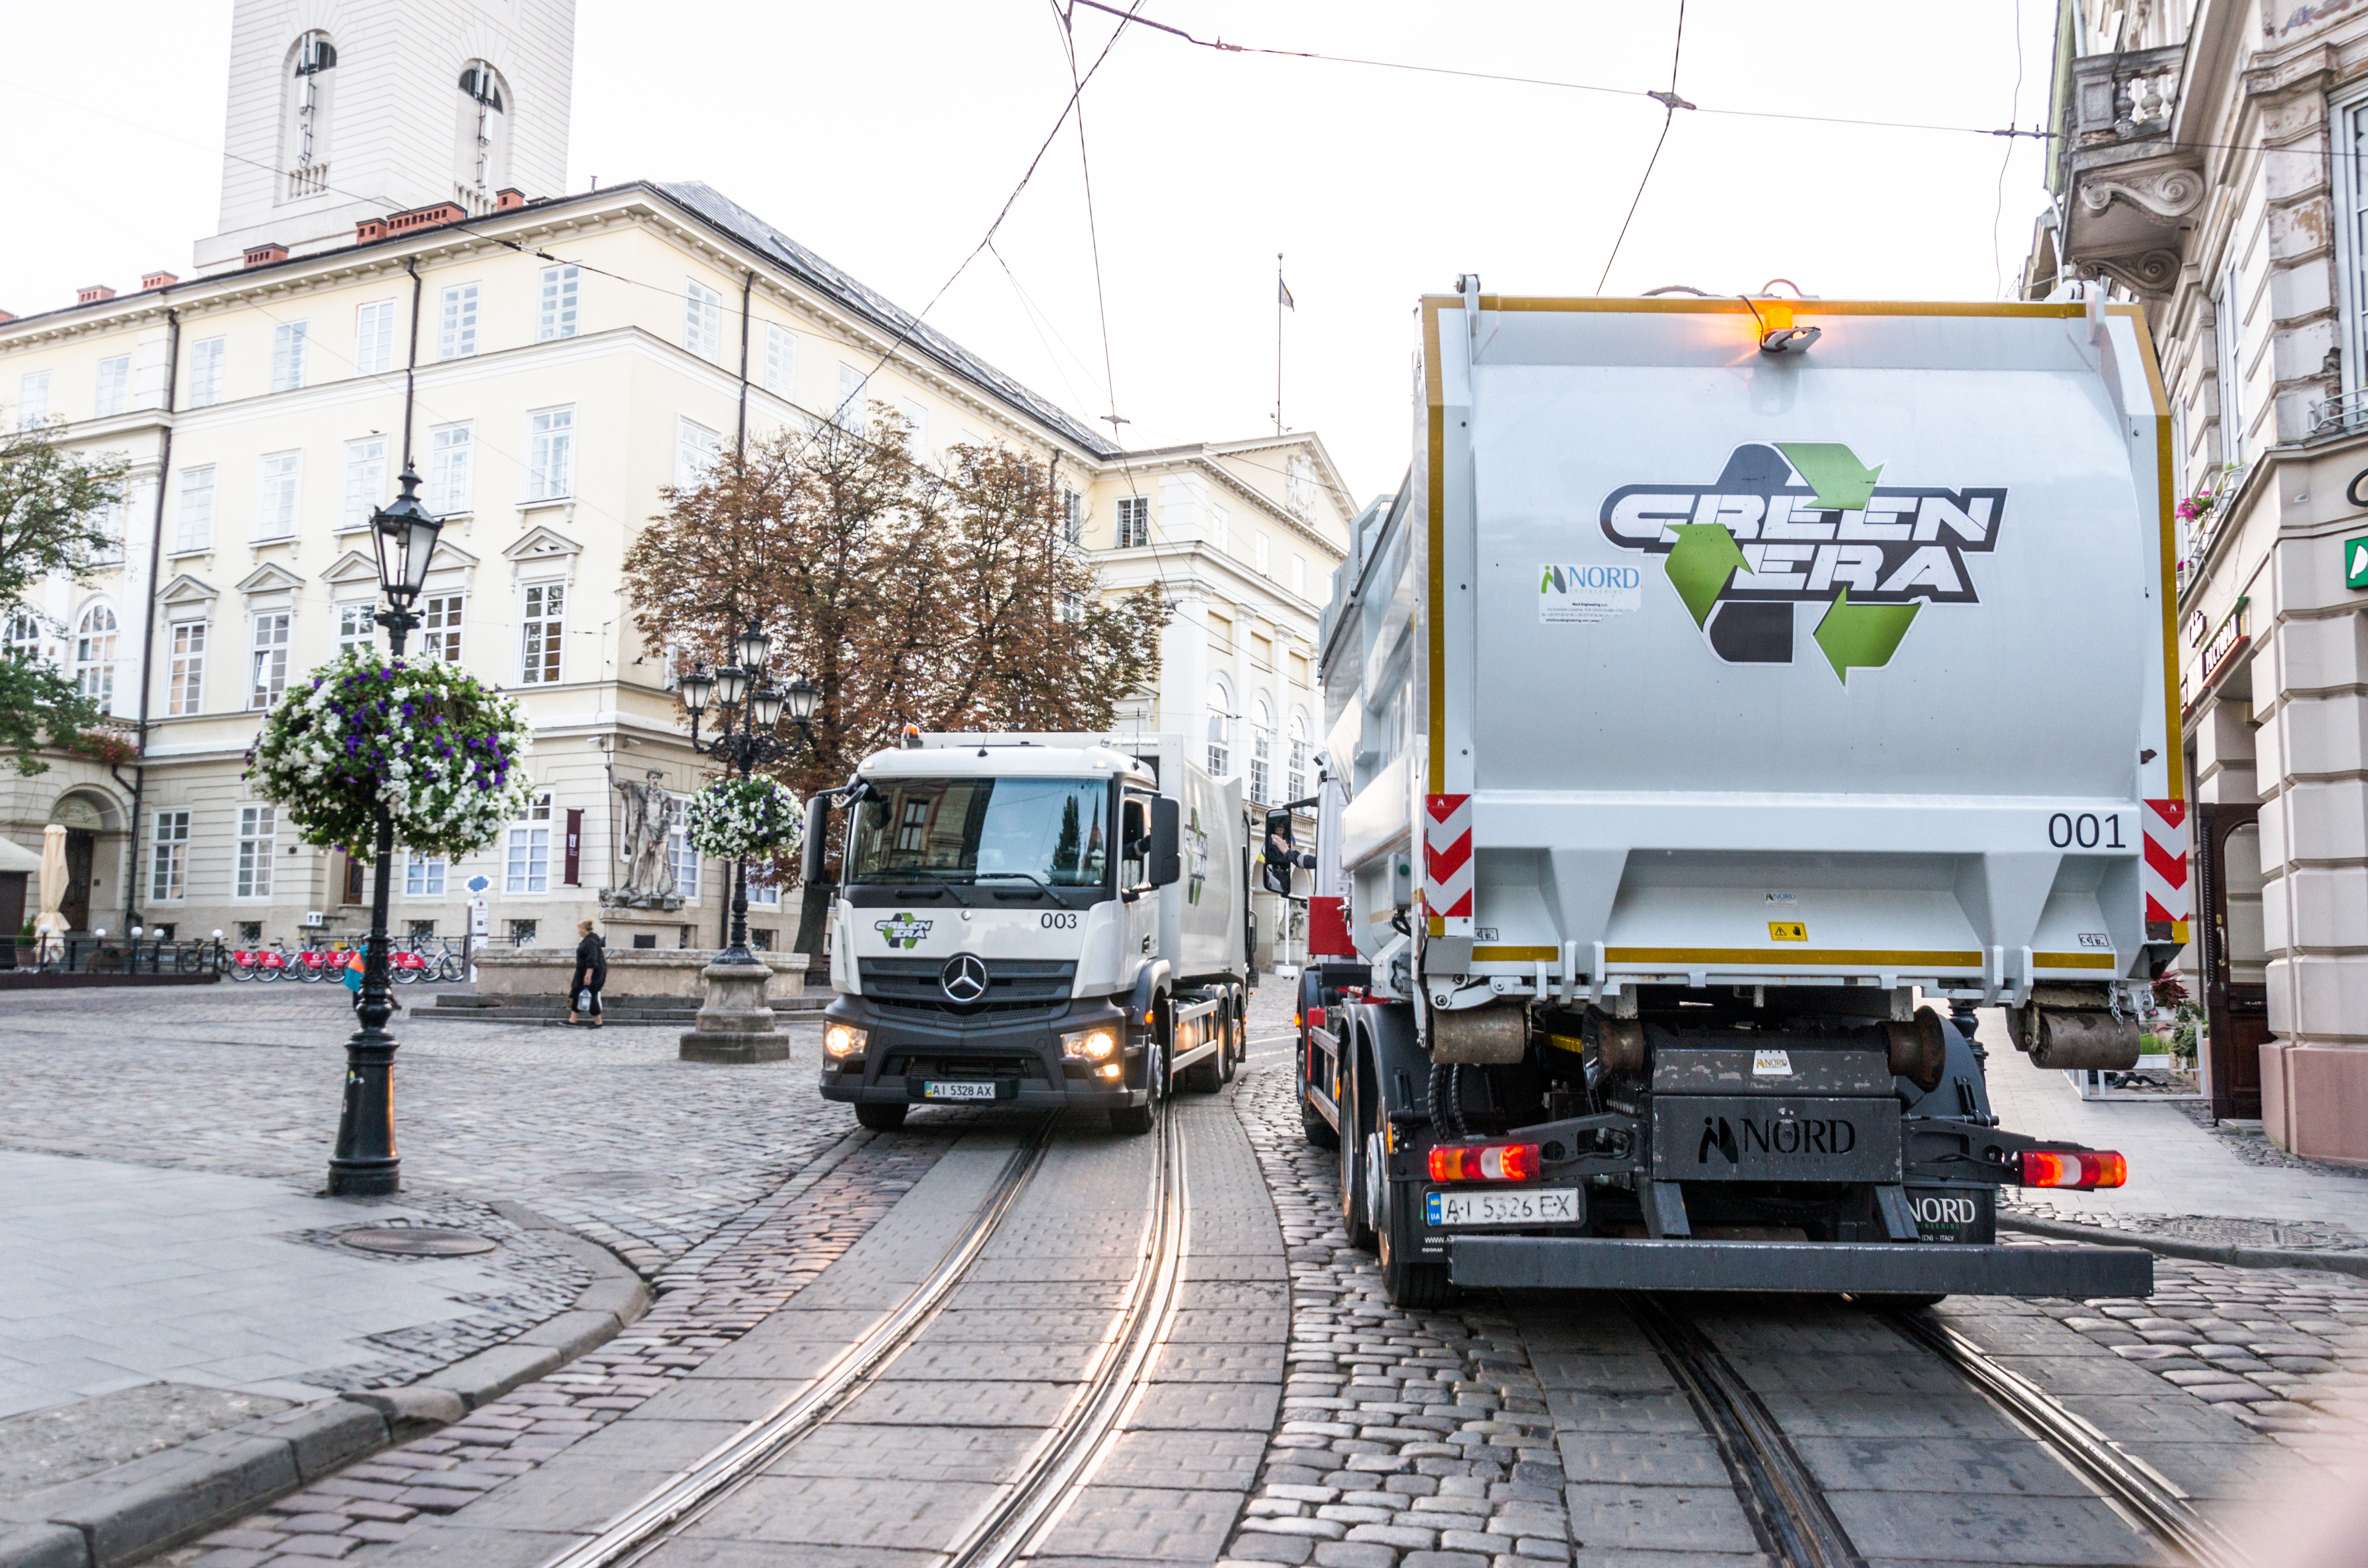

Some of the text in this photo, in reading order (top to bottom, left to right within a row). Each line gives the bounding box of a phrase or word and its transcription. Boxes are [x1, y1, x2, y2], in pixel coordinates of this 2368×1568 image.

[1610, 493, 1995, 542] GREEN
[1567, 566, 1640, 588] NORD
[1731, 543, 1964, 592] ERA
[2048, 813, 2126, 848] 001
[876, 921, 931, 930] GREEN
[1041, 913, 1077, 929] 003
[891, 929, 925, 937] ERA
[1764, 1058, 1788, 1067] NORD
[933, 1085, 992, 1096] AI 5328 AX
[1739, 1118, 1855, 1153] NORD
[1446, 1199, 1470, 1219] AI
[1540, 1195, 1570, 1217] EX
